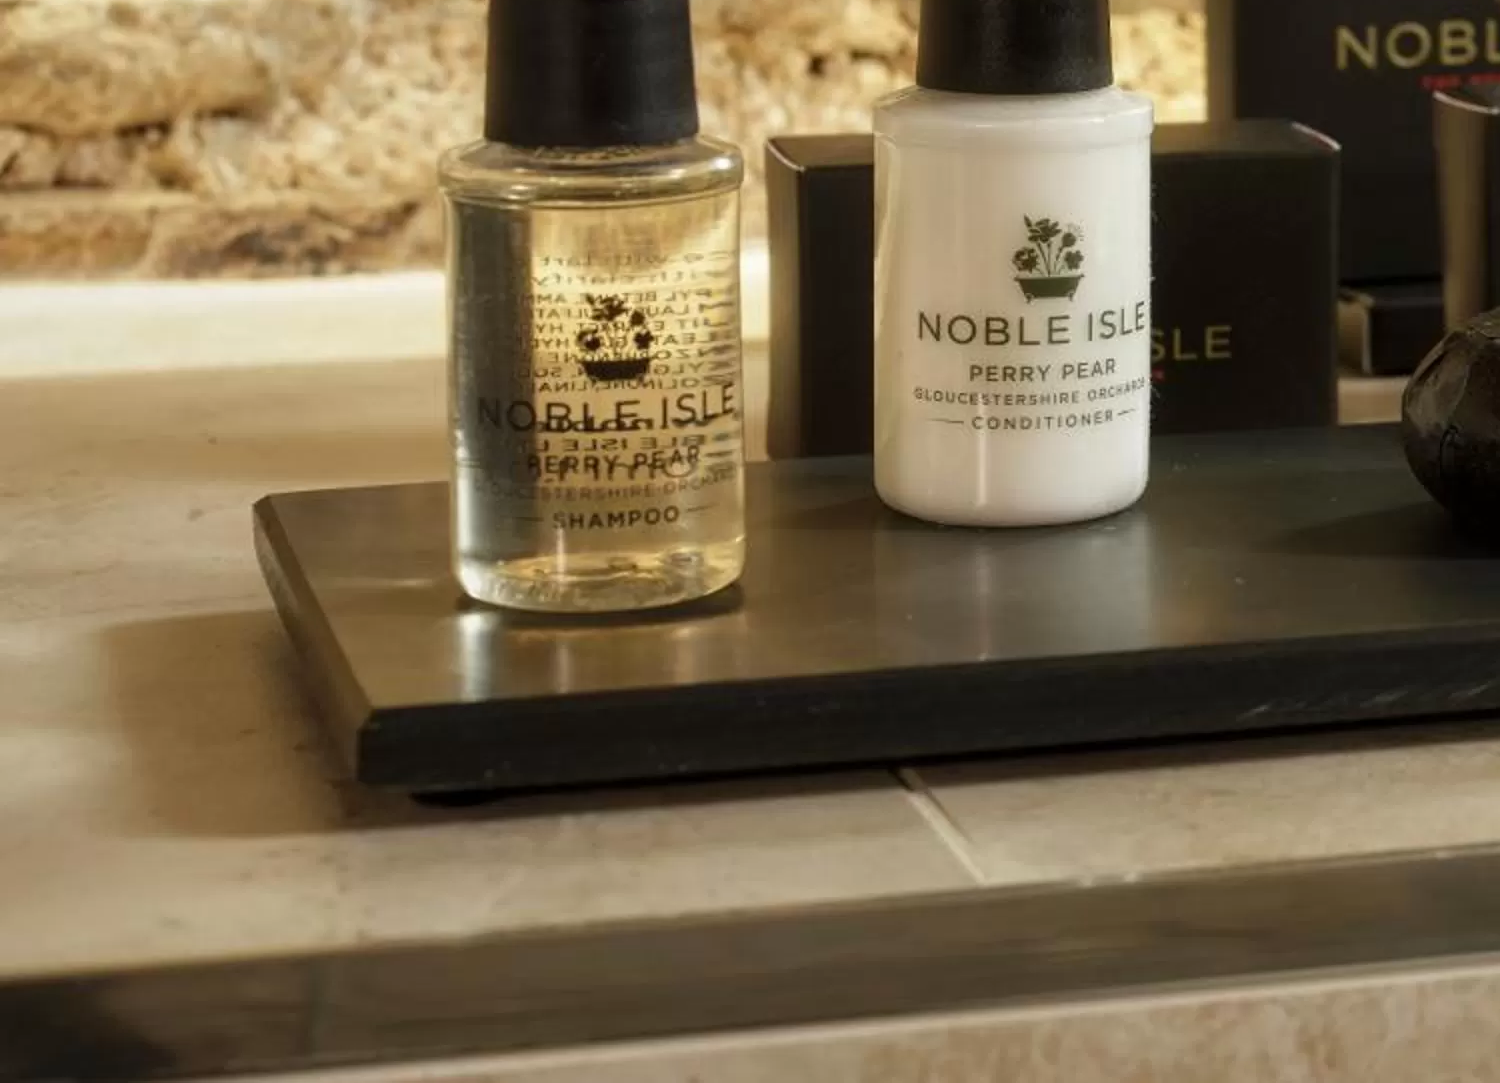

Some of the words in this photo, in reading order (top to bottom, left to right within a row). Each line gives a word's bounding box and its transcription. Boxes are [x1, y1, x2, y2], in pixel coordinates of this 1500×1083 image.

[917, 310, 1071, 347] NOBLE
[1086, 300, 1146, 343] ISLE
[1149, 324, 1234, 364] SLE
[969, 363, 1052, 383] PERRY
[1061, 358, 1117, 381] PEAR
[477, 396, 641, 433] NOBLE
[661, 382, 736, 430] ISLE
[913, 386, 1080, 407] GLOUCESTERSHIRE
[970, 408, 1114, 431] CONDITIONER
[552, 504, 681, 531] SHAMPOO
